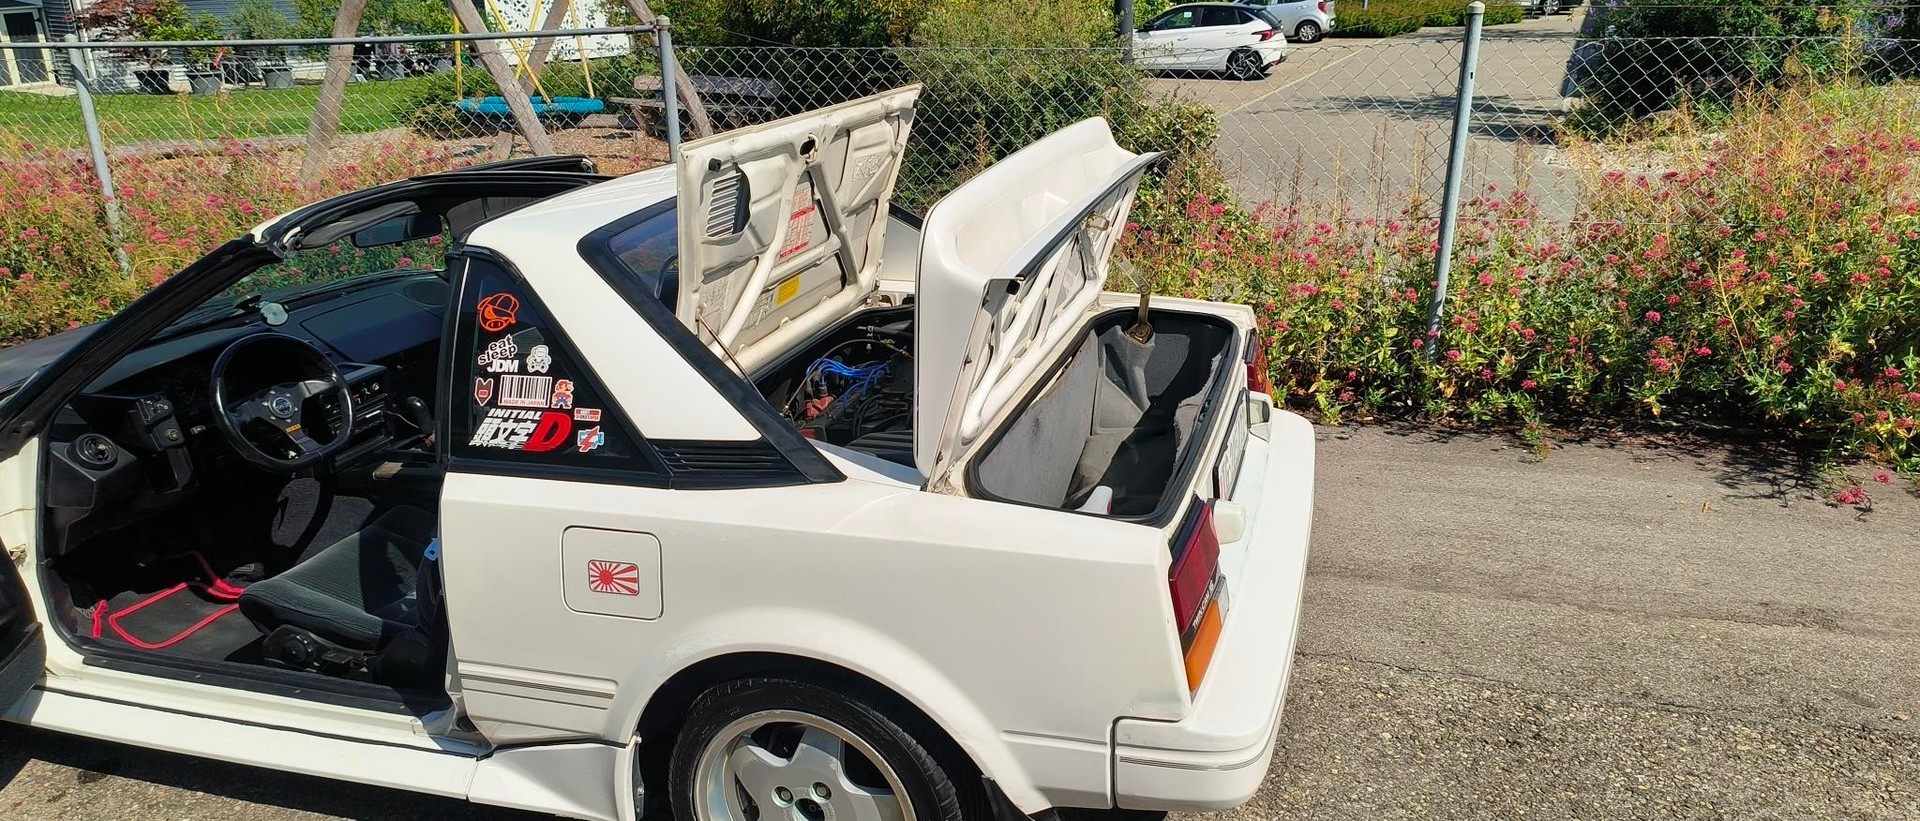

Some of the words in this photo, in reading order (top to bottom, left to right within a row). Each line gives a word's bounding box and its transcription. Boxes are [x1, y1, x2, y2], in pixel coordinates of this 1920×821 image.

[489, 334, 513, 351] eat
[478, 345, 517, 364] sleep
[487, 360, 519, 373] JDM
[487, 408, 542, 420] INITIAL
[522, 411, 572, 452] D
